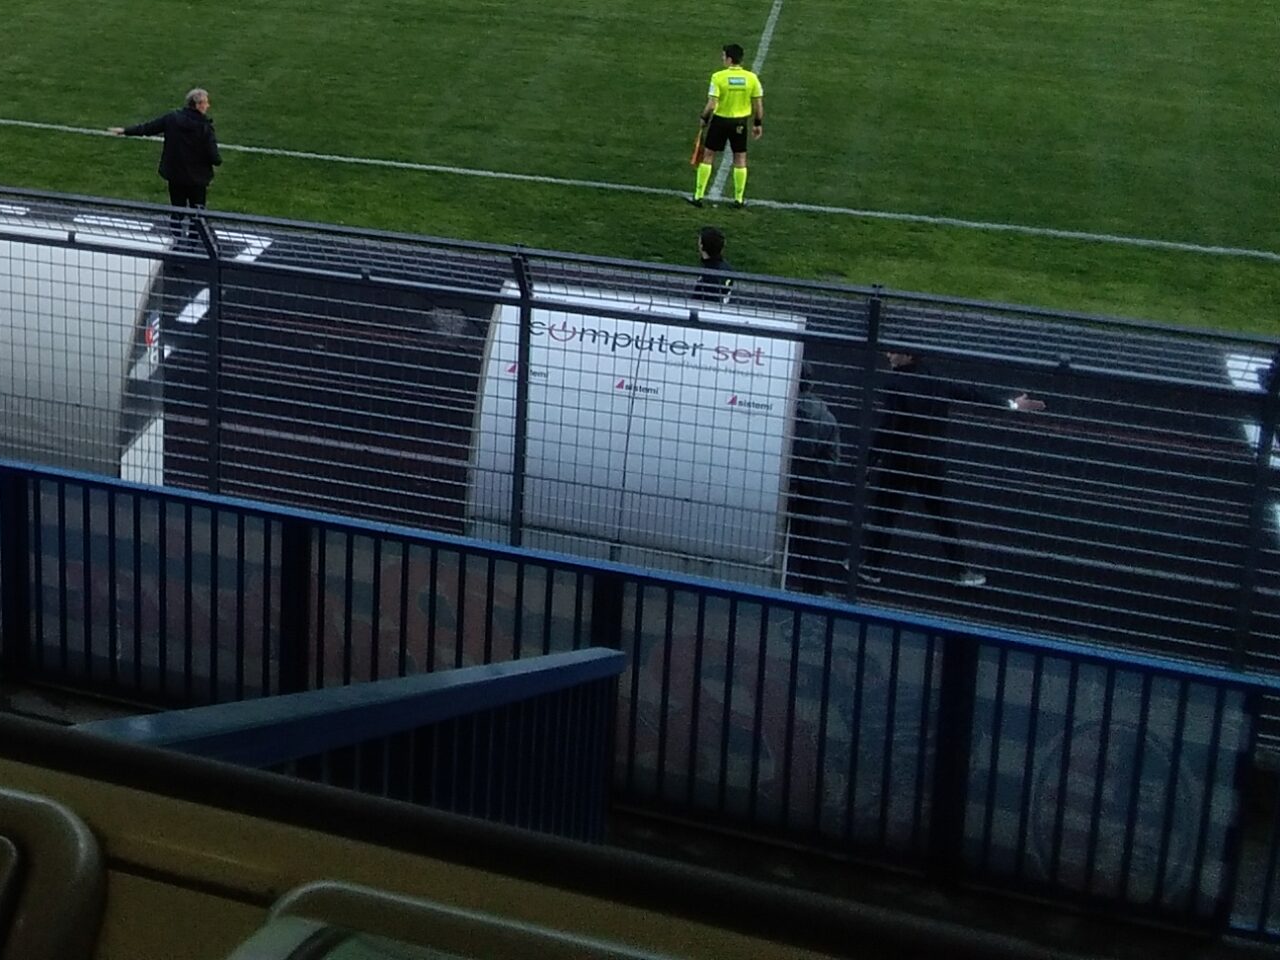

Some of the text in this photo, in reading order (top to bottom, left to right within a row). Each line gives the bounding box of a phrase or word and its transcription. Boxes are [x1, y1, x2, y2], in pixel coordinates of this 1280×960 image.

[530, 320, 766, 367] computer set
[624, 382, 659, 395] sistemi
[737, 399, 773, 411] sistemi
